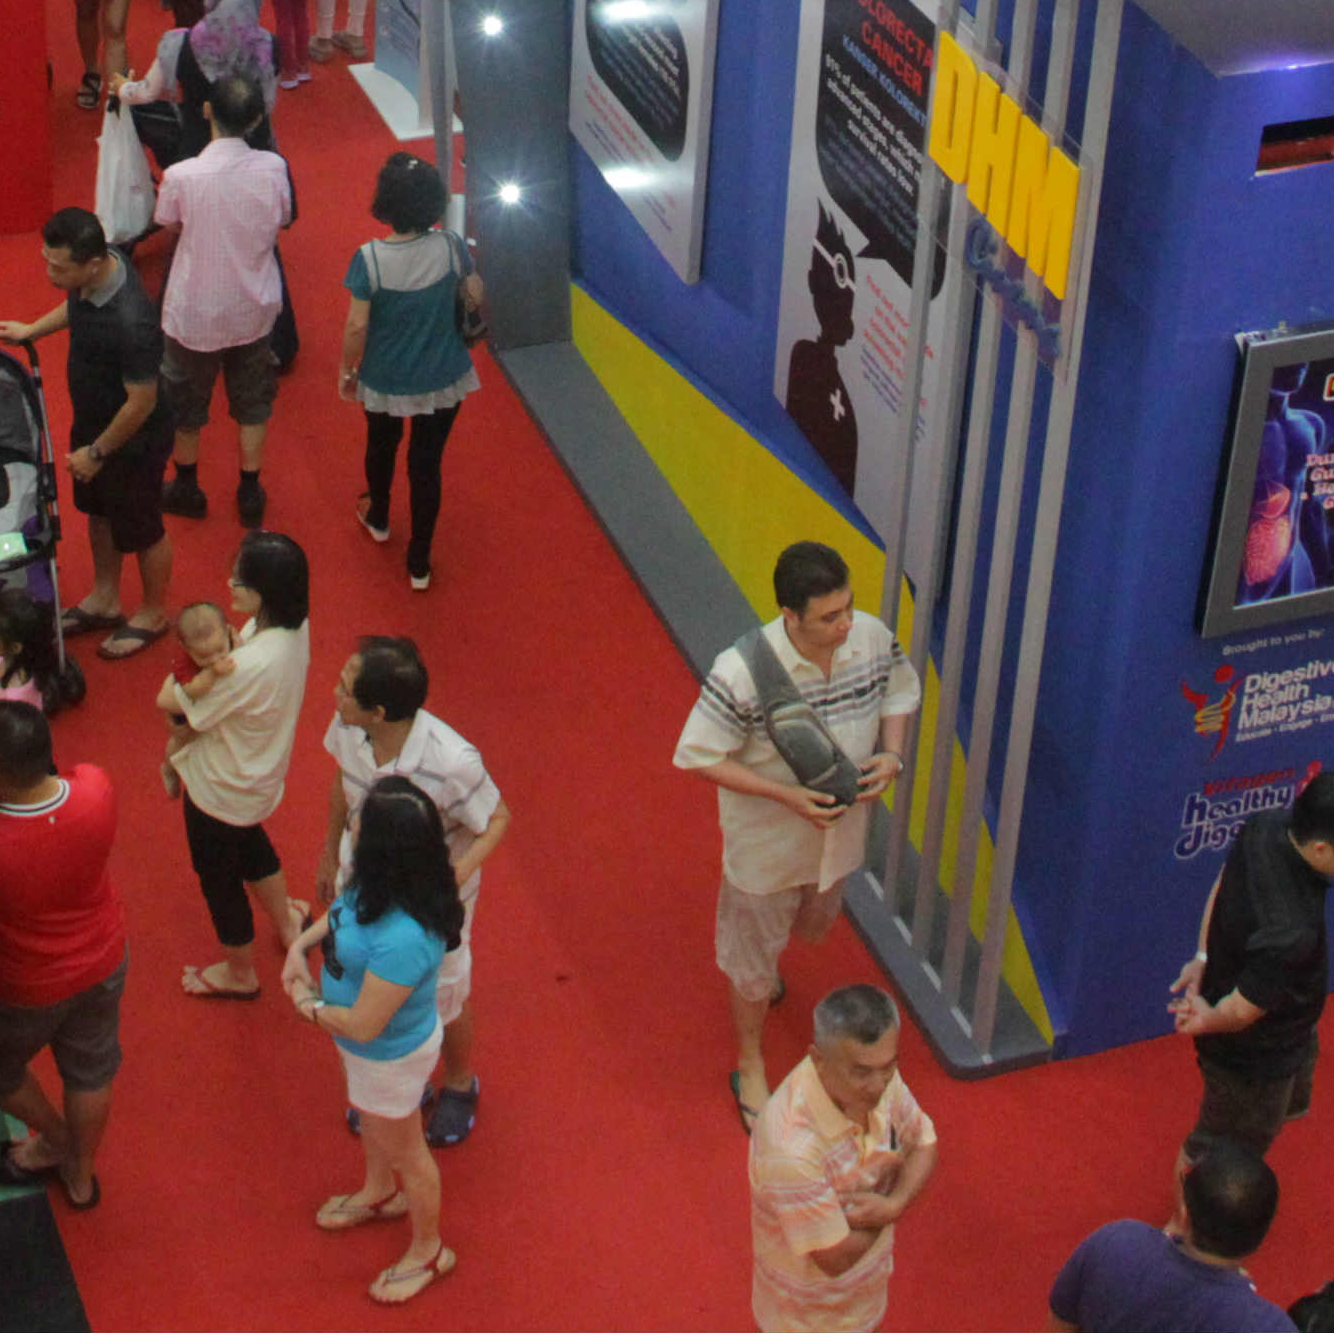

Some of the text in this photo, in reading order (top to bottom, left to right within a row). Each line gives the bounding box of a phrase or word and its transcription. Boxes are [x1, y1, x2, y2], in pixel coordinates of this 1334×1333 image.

[861, 20, 923, 97] CANCER
[927, 30, 1081, 301] DHM
[1238, 694, 1333, 731] Malaysia
[1241, 682, 1310, 712] Health
[1182, 782, 1295, 828] healthy
